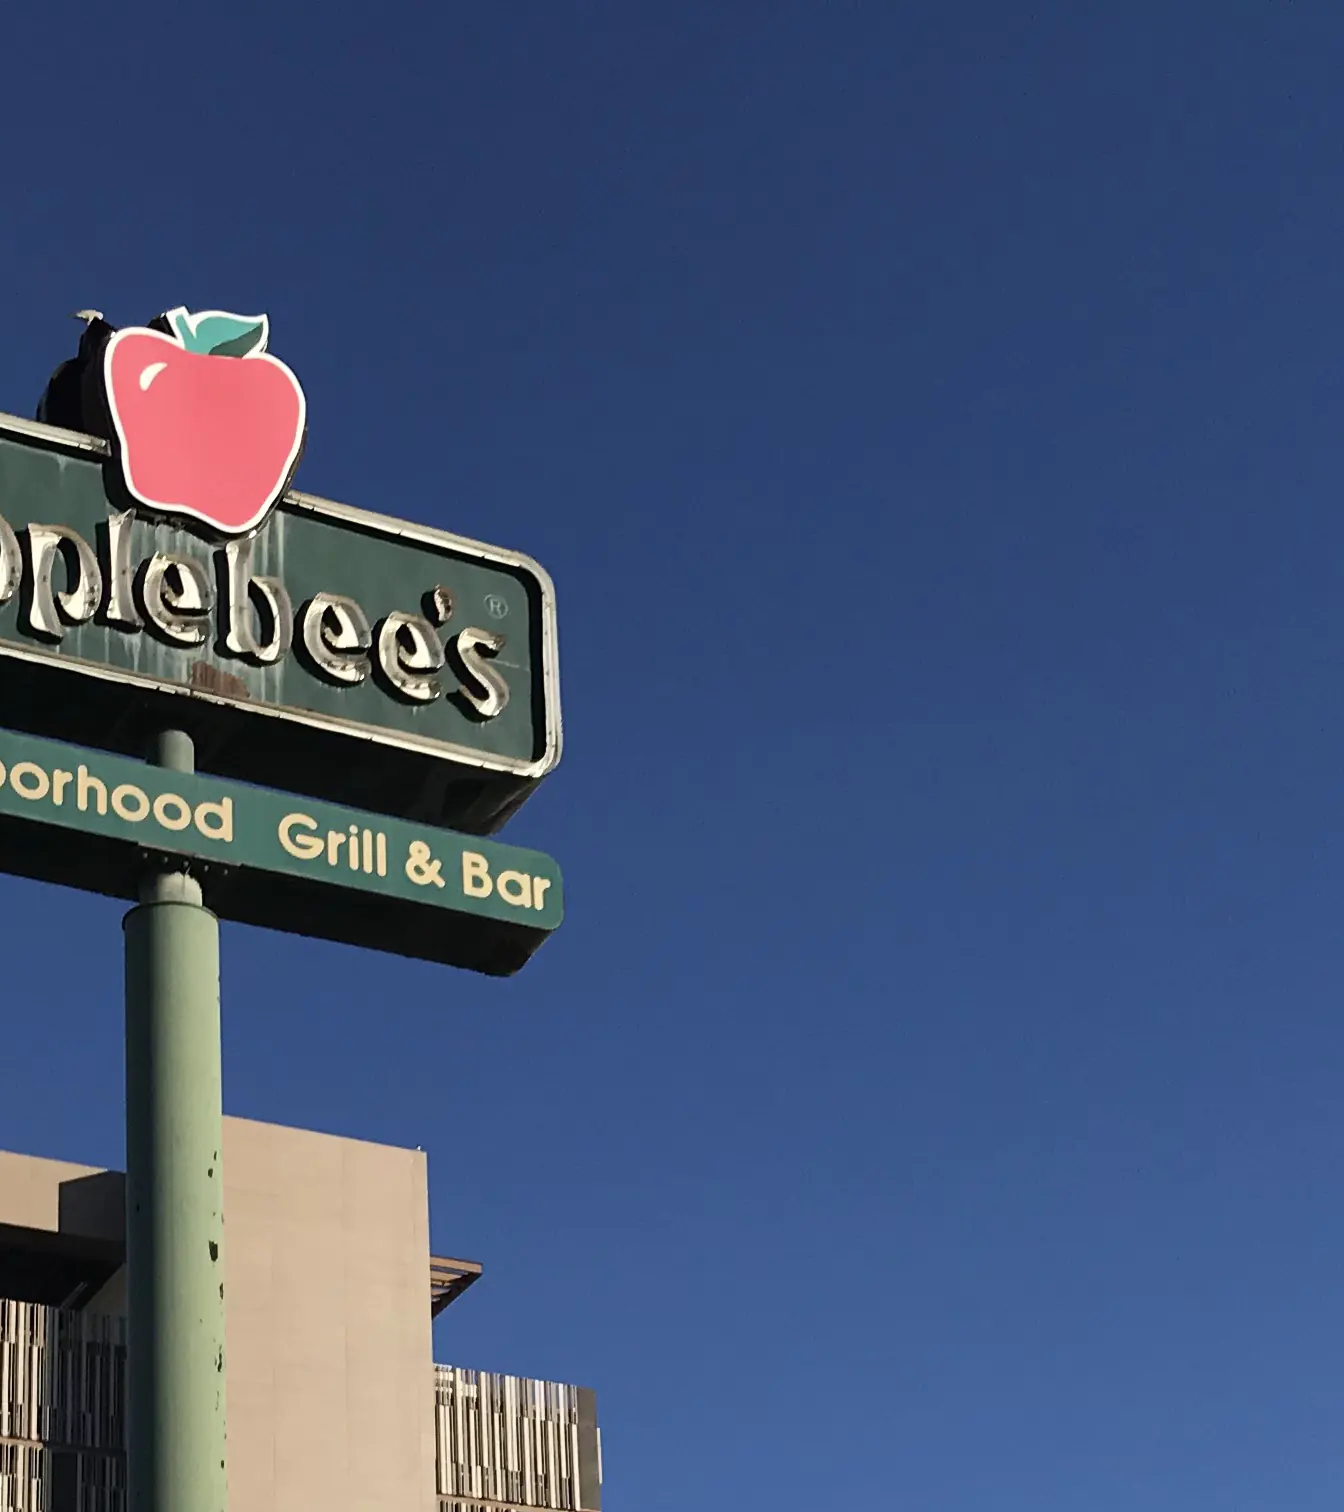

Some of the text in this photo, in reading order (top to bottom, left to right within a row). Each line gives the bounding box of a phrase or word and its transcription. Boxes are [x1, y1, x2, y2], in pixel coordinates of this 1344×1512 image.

[278, 812, 388, 878] Grill
[405, 841, 445, 889] &
[462, 850, 551, 912] Bar
